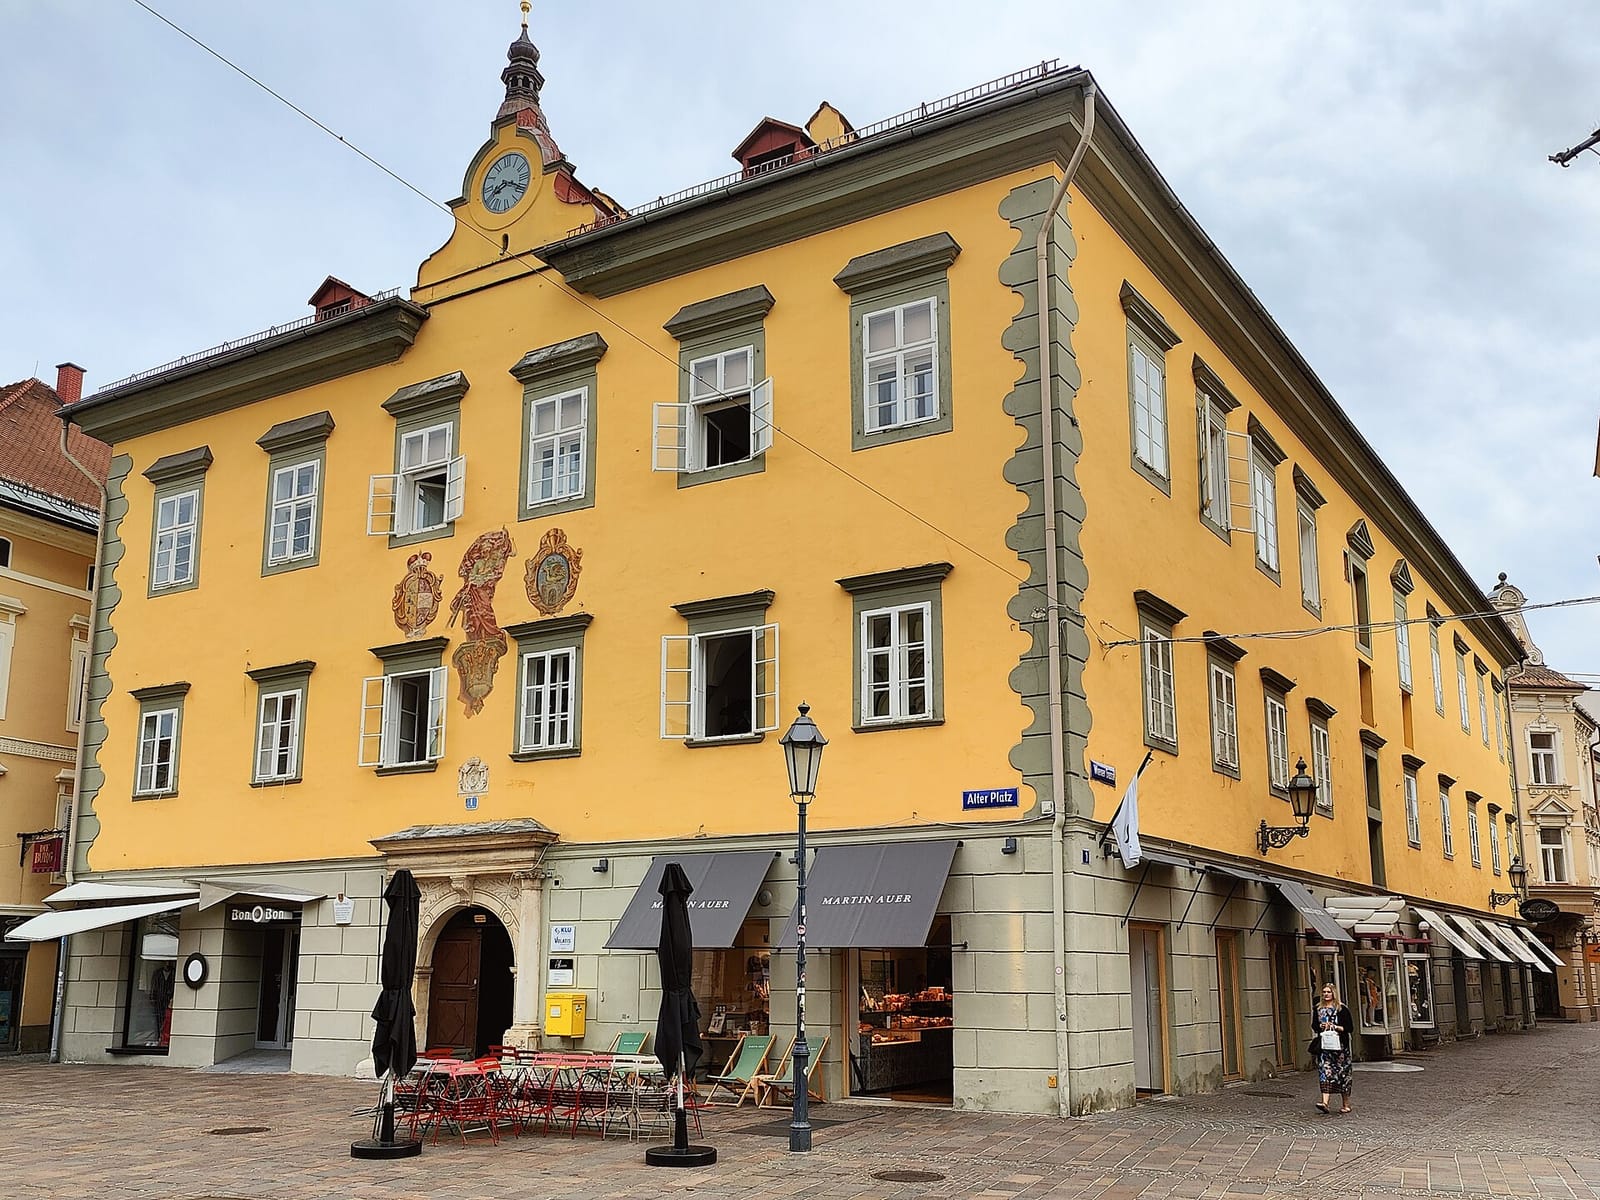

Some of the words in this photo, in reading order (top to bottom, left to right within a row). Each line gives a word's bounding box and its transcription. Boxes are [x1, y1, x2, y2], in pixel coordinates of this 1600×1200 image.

[967, 793, 988, 805] Alter
[990, 791, 1013, 803] Platz
[698, 901, 729, 909] AUER
[822, 896, 873, 905] MARTIN
[876, 894, 911, 903] AUER
